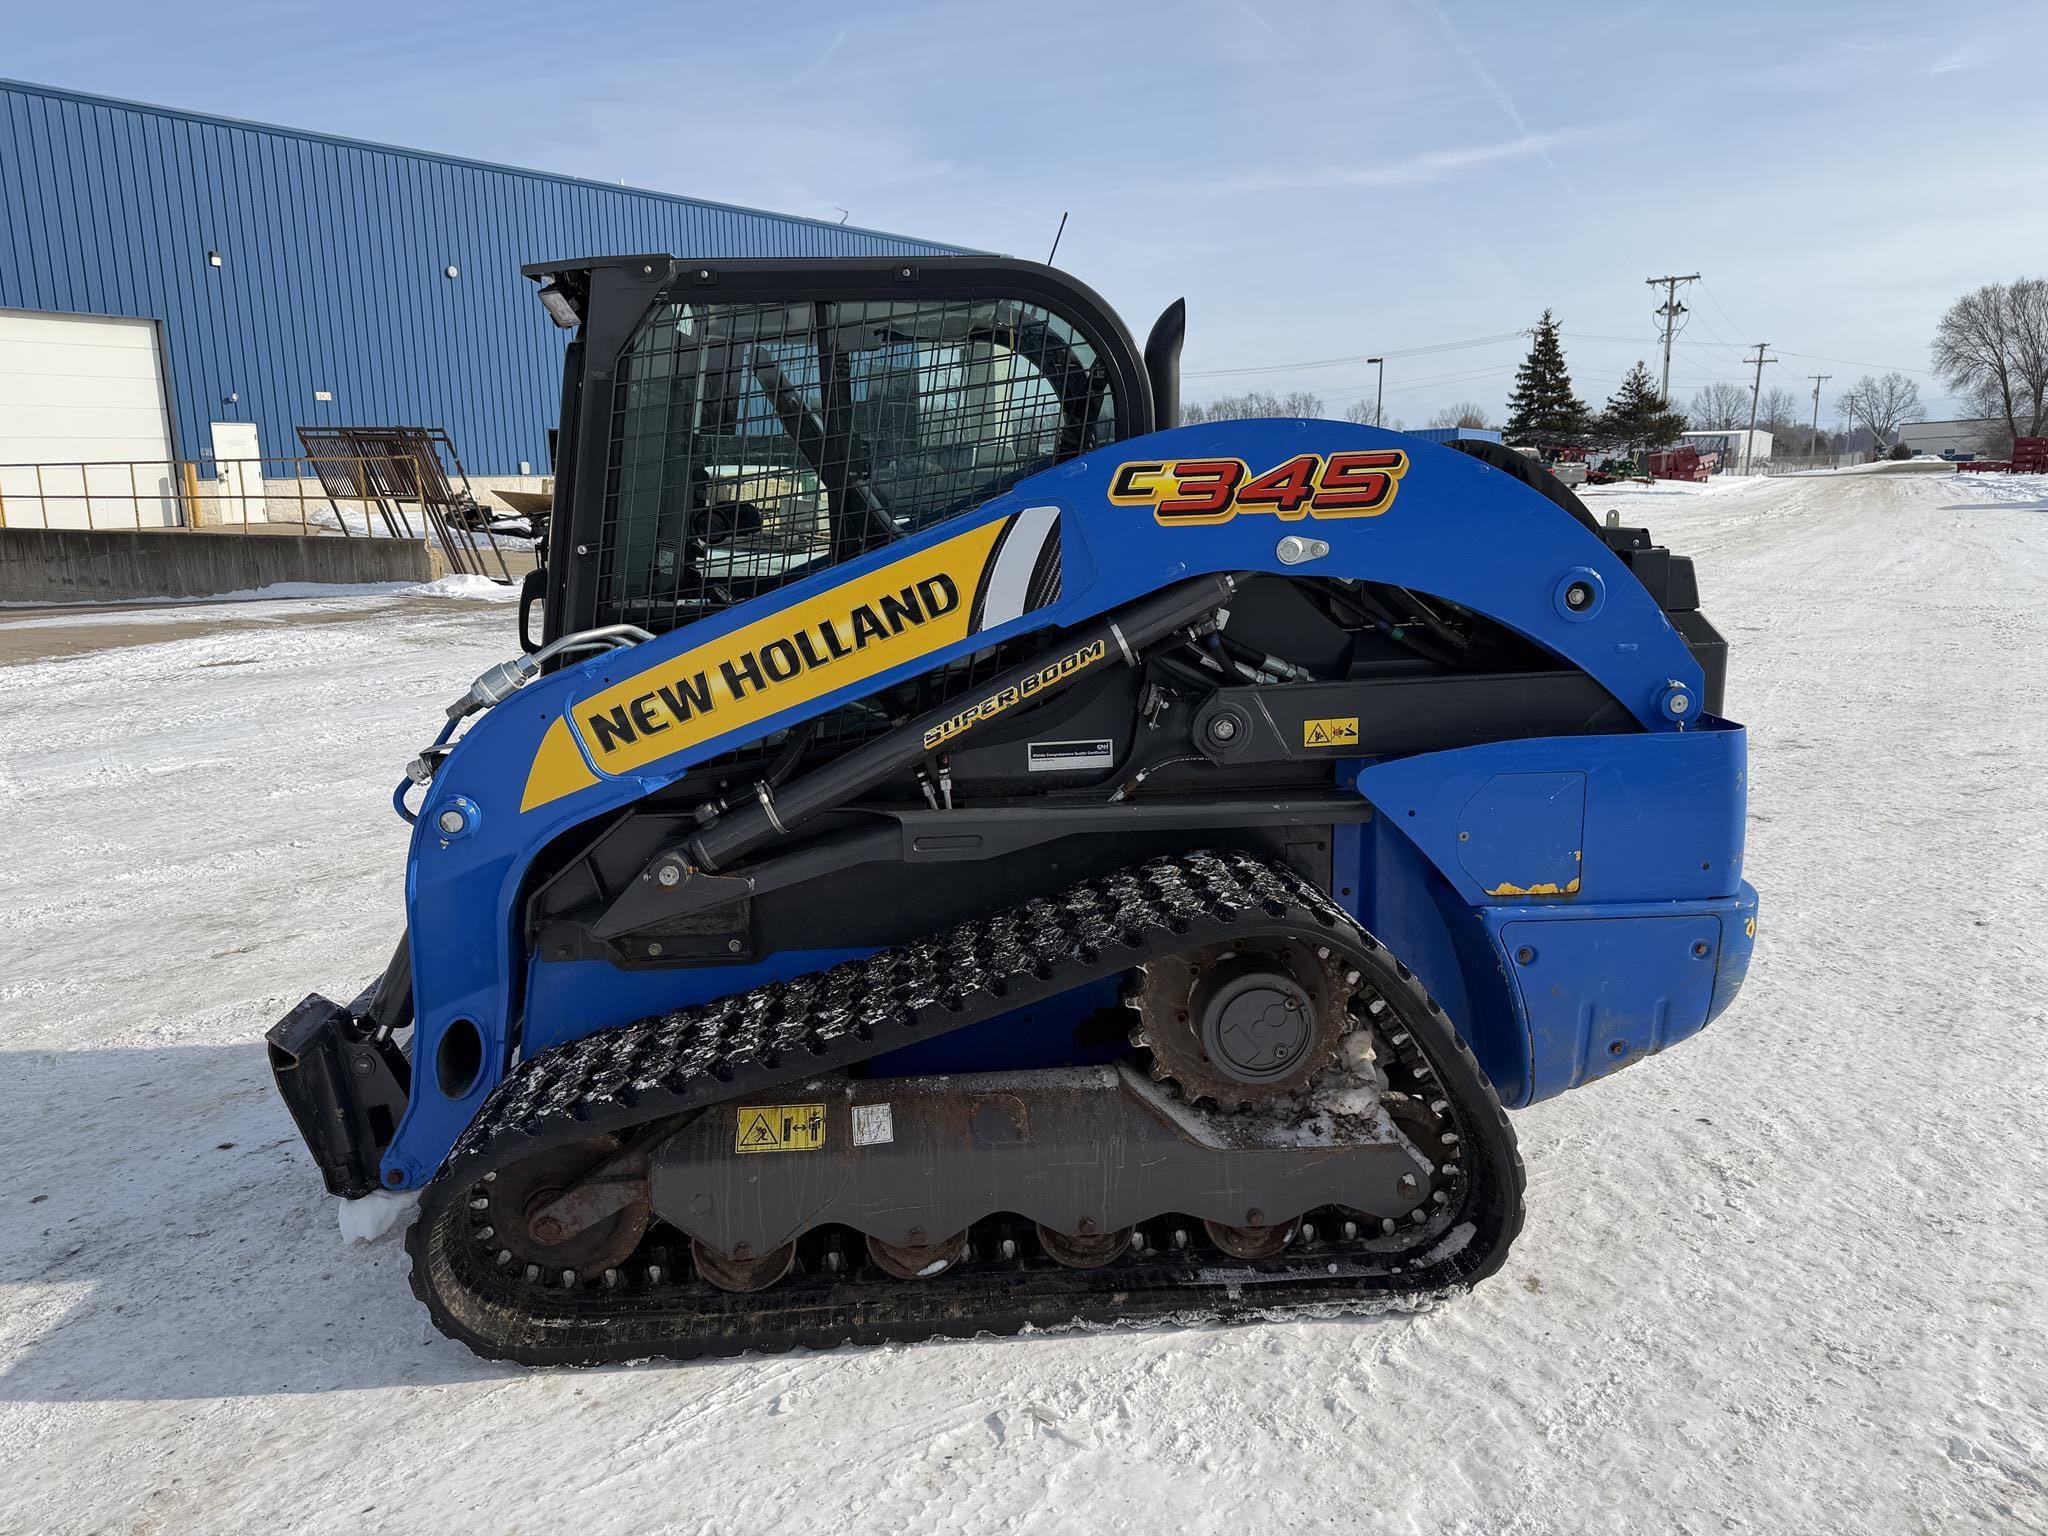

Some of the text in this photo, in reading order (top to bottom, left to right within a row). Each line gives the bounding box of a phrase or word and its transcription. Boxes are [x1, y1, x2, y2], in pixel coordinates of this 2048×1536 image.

[1109, 450, 1408, 524] C345
[587, 572, 961, 754] NEW HOLLAND
[923, 639, 1105, 750] SUPER BOOM
